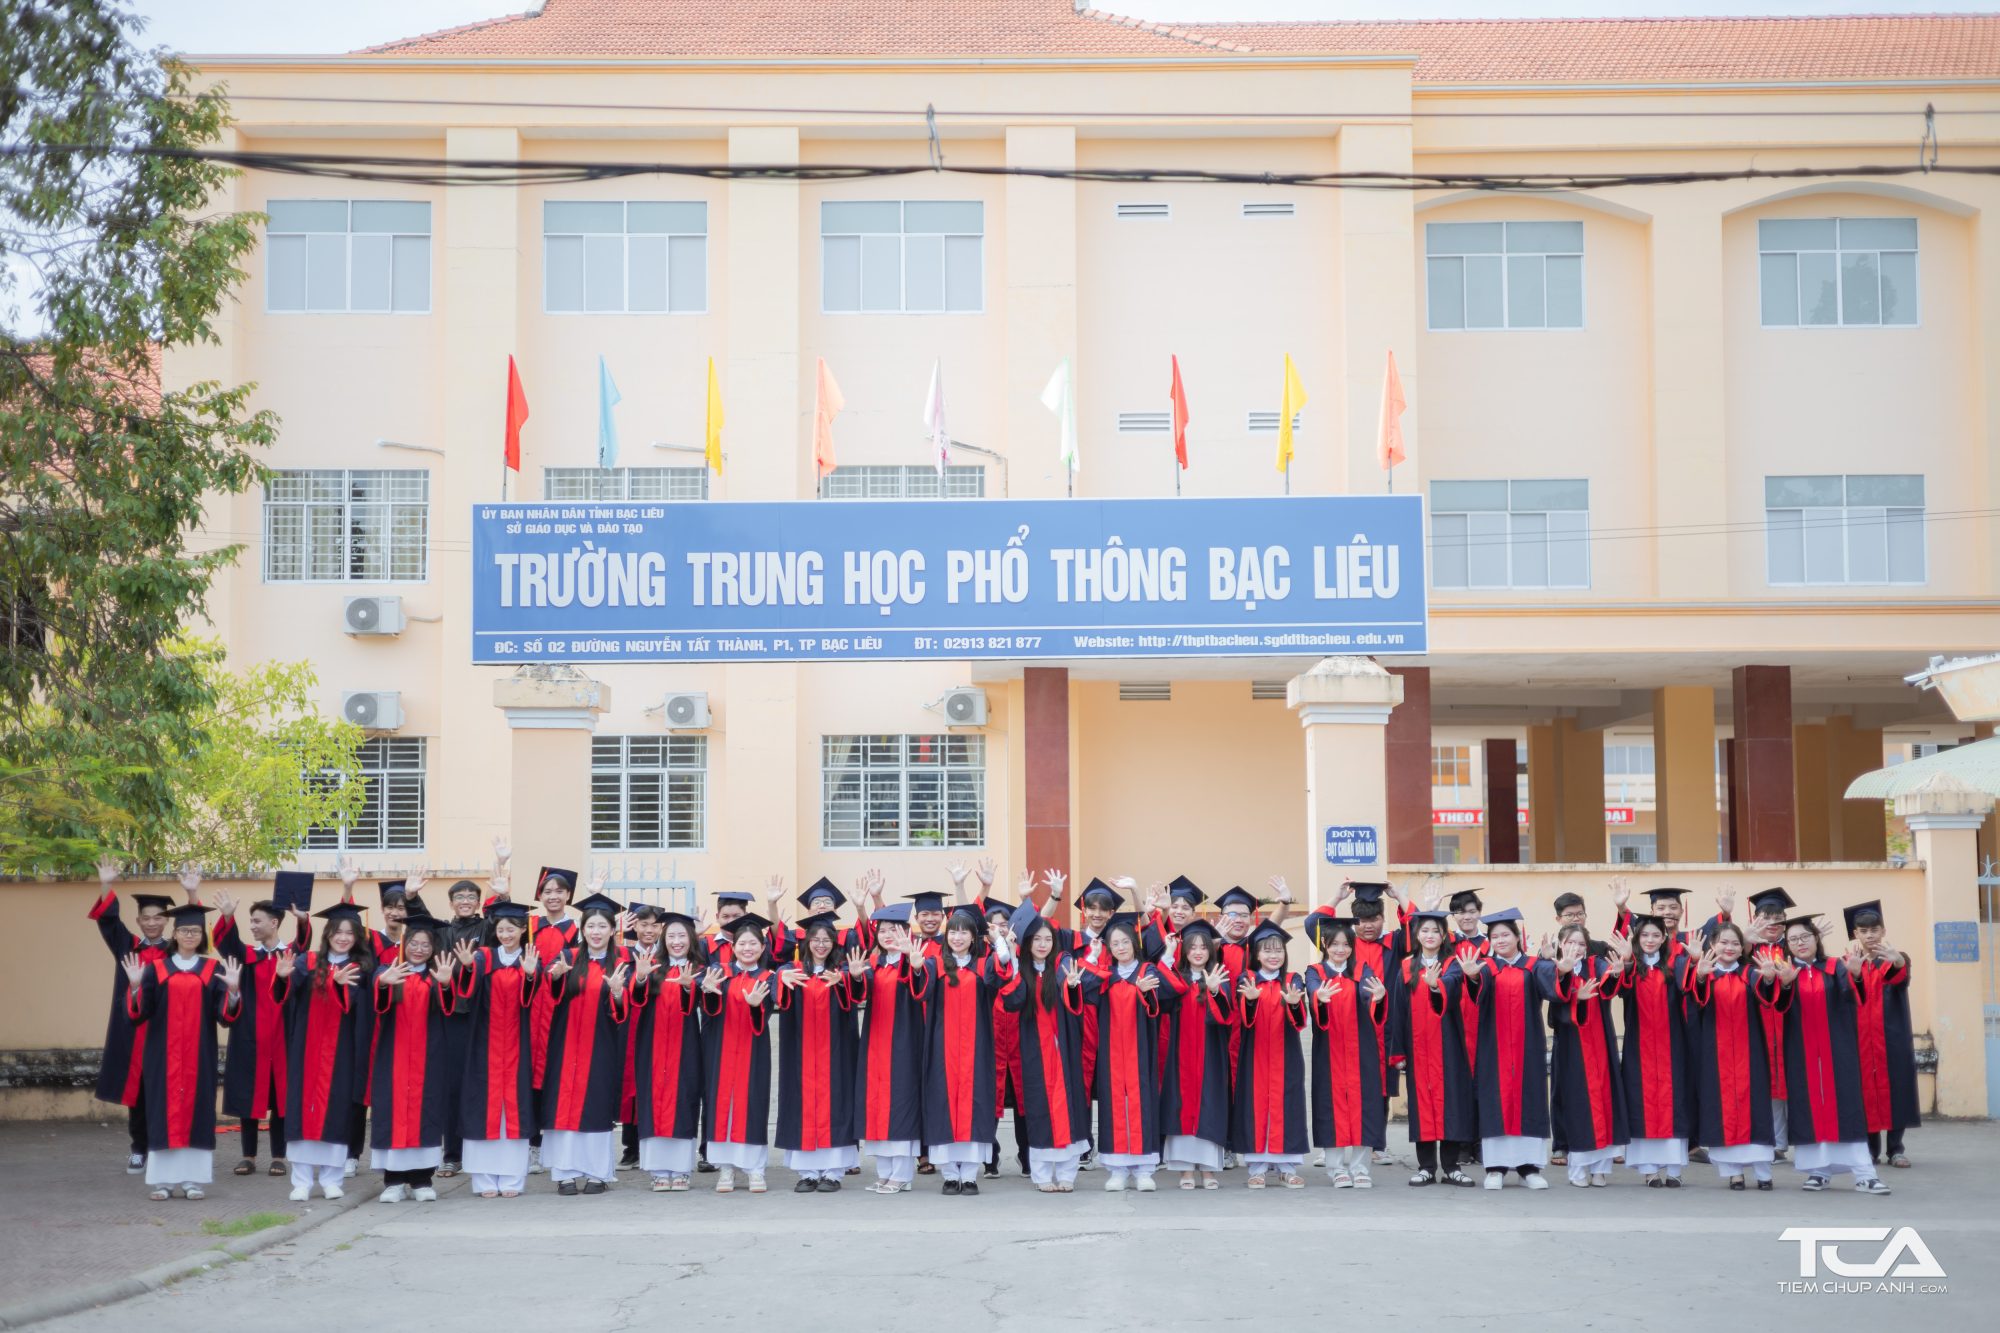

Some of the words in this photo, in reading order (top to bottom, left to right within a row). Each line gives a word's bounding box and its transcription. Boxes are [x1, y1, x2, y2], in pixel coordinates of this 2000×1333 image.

[482, 506, 497, 519] ỦY
[500, 509, 524, 519] BAN
[526, 507, 559, 519] NHÂN
[561, 507, 586, 519] DÂN
[589, 506, 614, 519] TỈNH
[615, 509, 638, 521] BẠC
[641, 507, 665, 519] LIÊU
[506, 521, 522, 534] SỞ
[525, 522, 551, 534] GIÁO
[554, 524, 577, 536] DỤC
[579, 521, 594, 534] VÀ
[597, 522, 620, 534] ĐÀO
[623, 523, 644, 536] TẠO
[494, 540, 666, 608] TRƯỜNG
[686, 550, 824, 606] TRUNG
[843, 549, 926, 616] HỌC
[946, 524, 1030, 604] PHỔ
[1050, 535, 1187, 603] THÔNG
[1208, 545, 1291, 611] BẠC
[1313, 533, 1400, 600] LIÊU
[494, 641, 518, 654] ĐC:
[523, 637, 543, 654] SỐ
[547, 641, 566, 653] 02
[571, 638, 620, 653] ĐƯỜNG
[625, 635, 682, 653] NGUYỄN
[687, 636, 711, 652] TẤT
[716, 637, 768, 653] THÀNH,
[773, 639, 794, 653] P1,
[798, 638, 817, 651] TP
[821, 638, 849, 653] BẠC
[853, 636, 883, 650] LIÊU
[914, 637, 938, 650] ĐT:
[943, 637, 985, 650] 02913
[988, 637, 1012, 649] 821
[1015, 636, 1042, 649] 877
[1073, 635, 1134, 648] Website:
[1438, 812, 1475, 823] THEO
